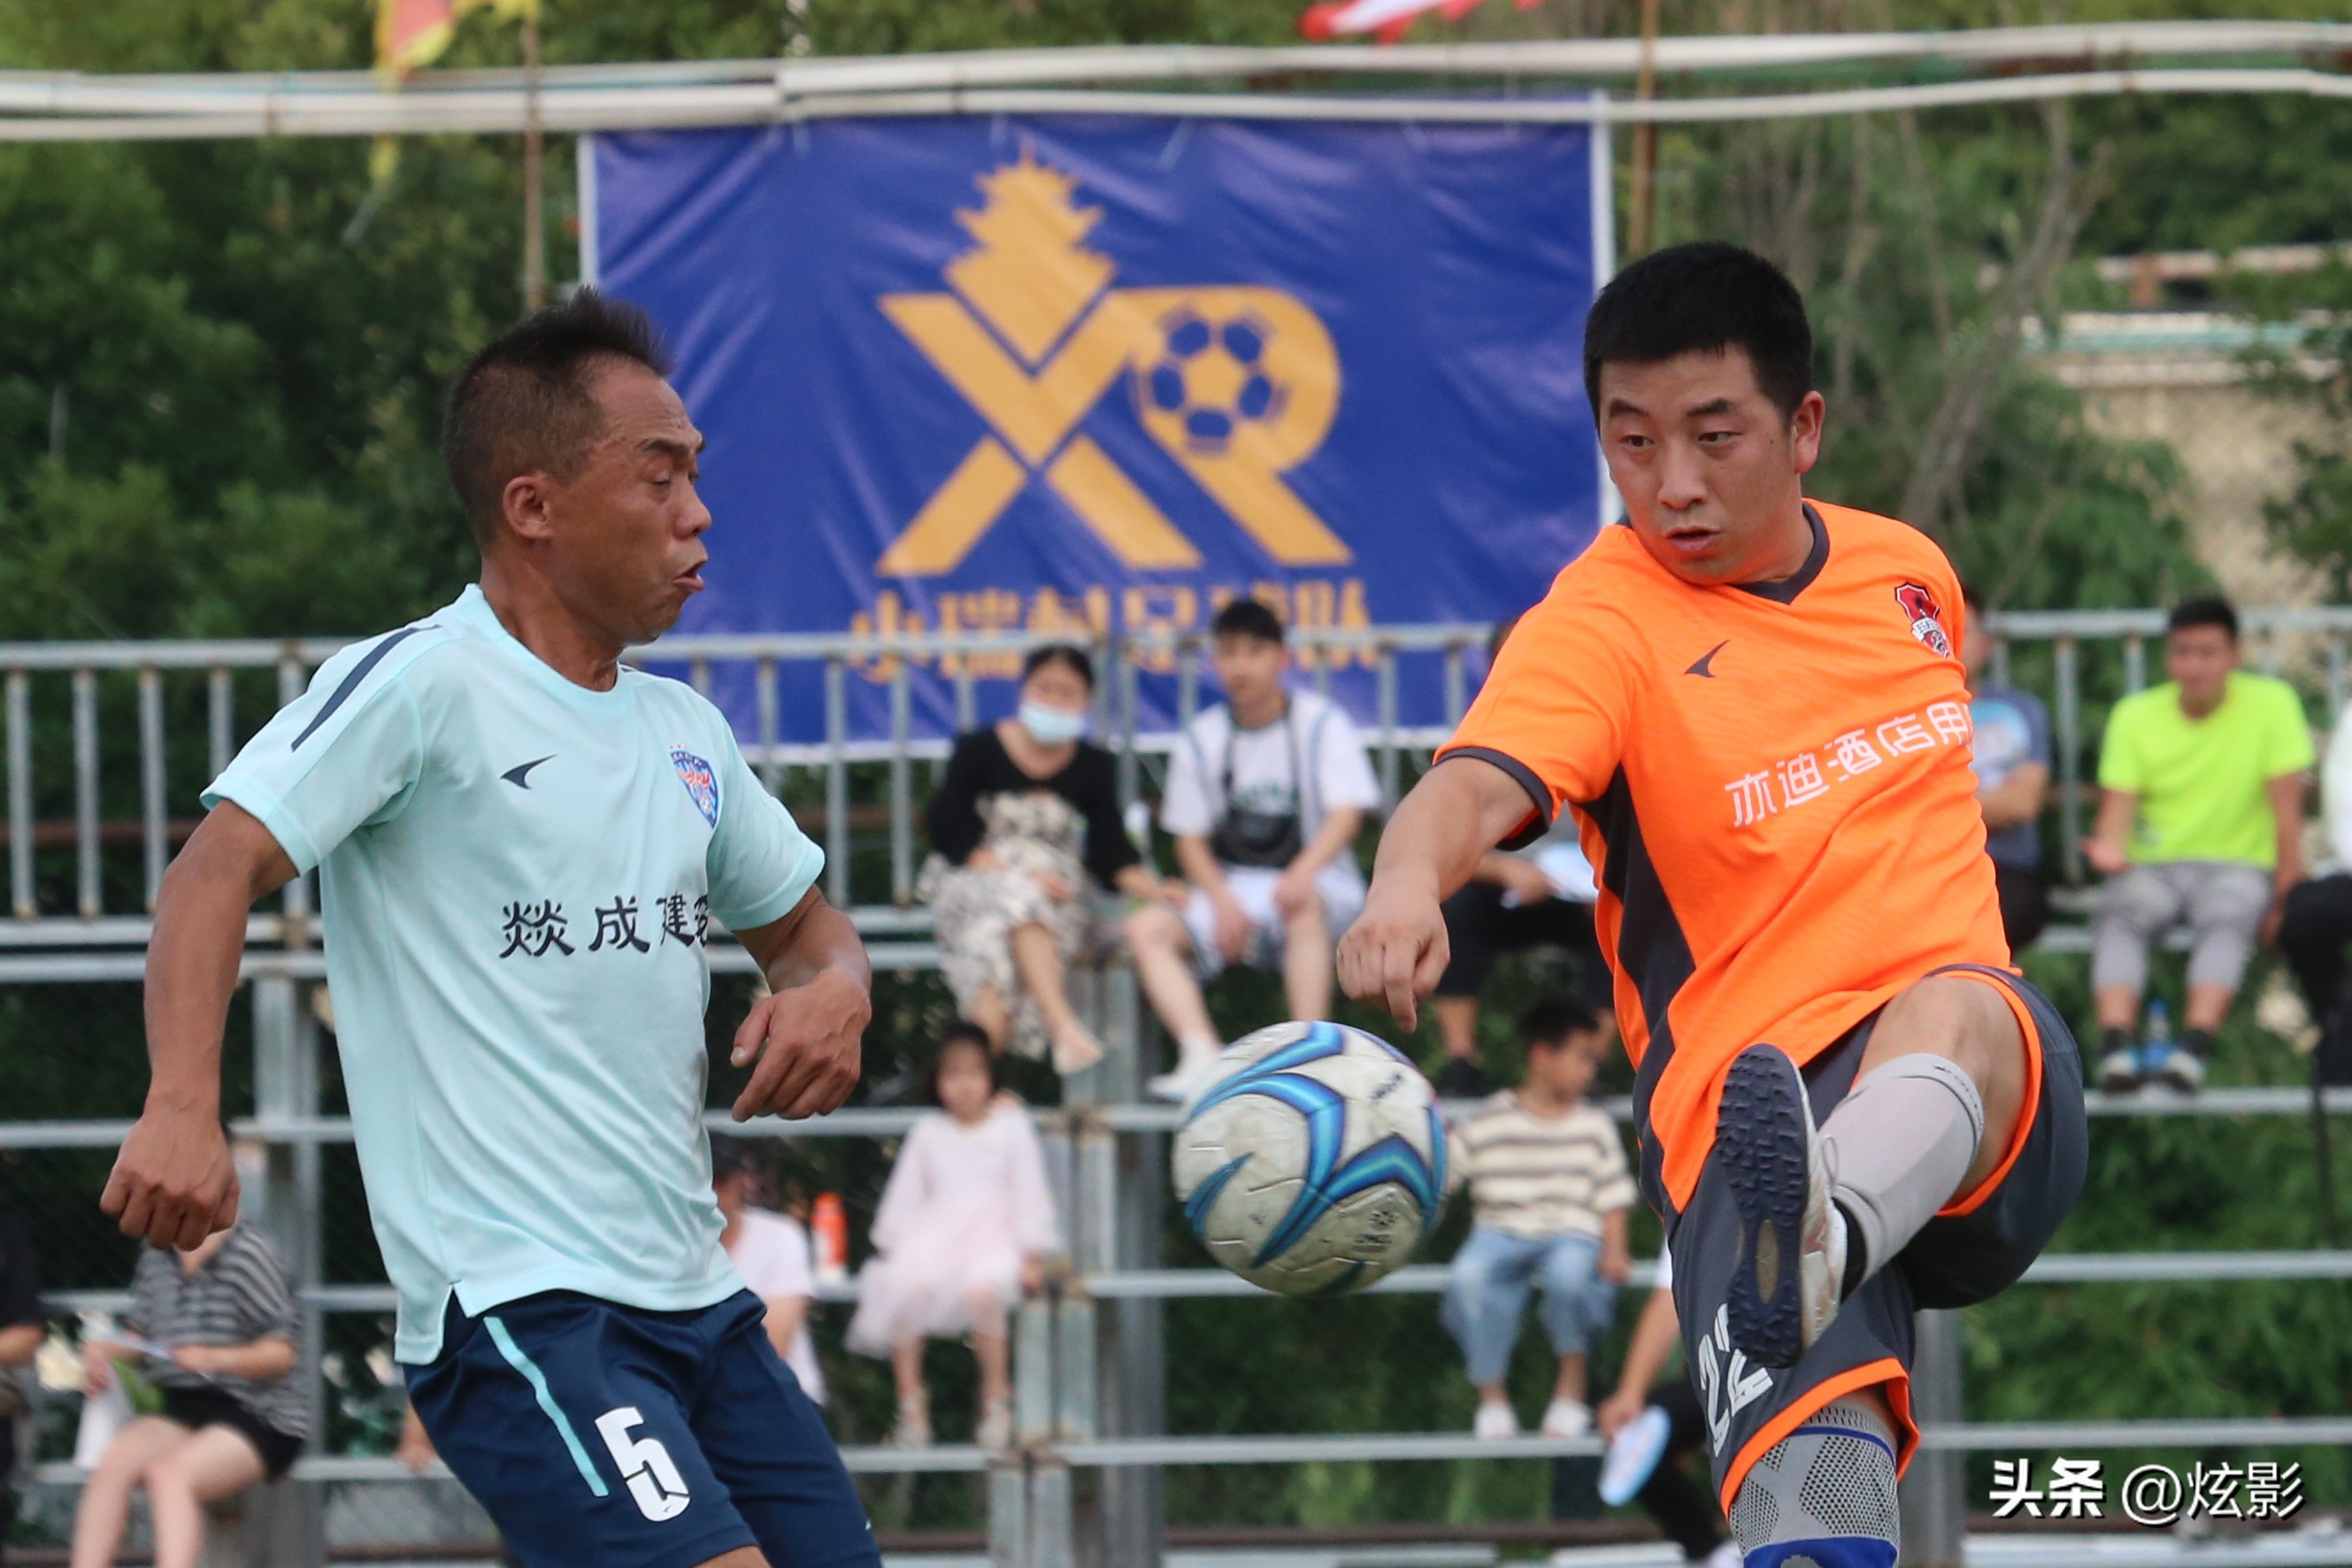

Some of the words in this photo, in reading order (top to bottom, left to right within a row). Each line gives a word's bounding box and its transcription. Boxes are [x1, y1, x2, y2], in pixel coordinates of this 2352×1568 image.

[1725, 702, 1974, 826] 亦迪酒店用
[595, 1406, 690, 1522] 5
